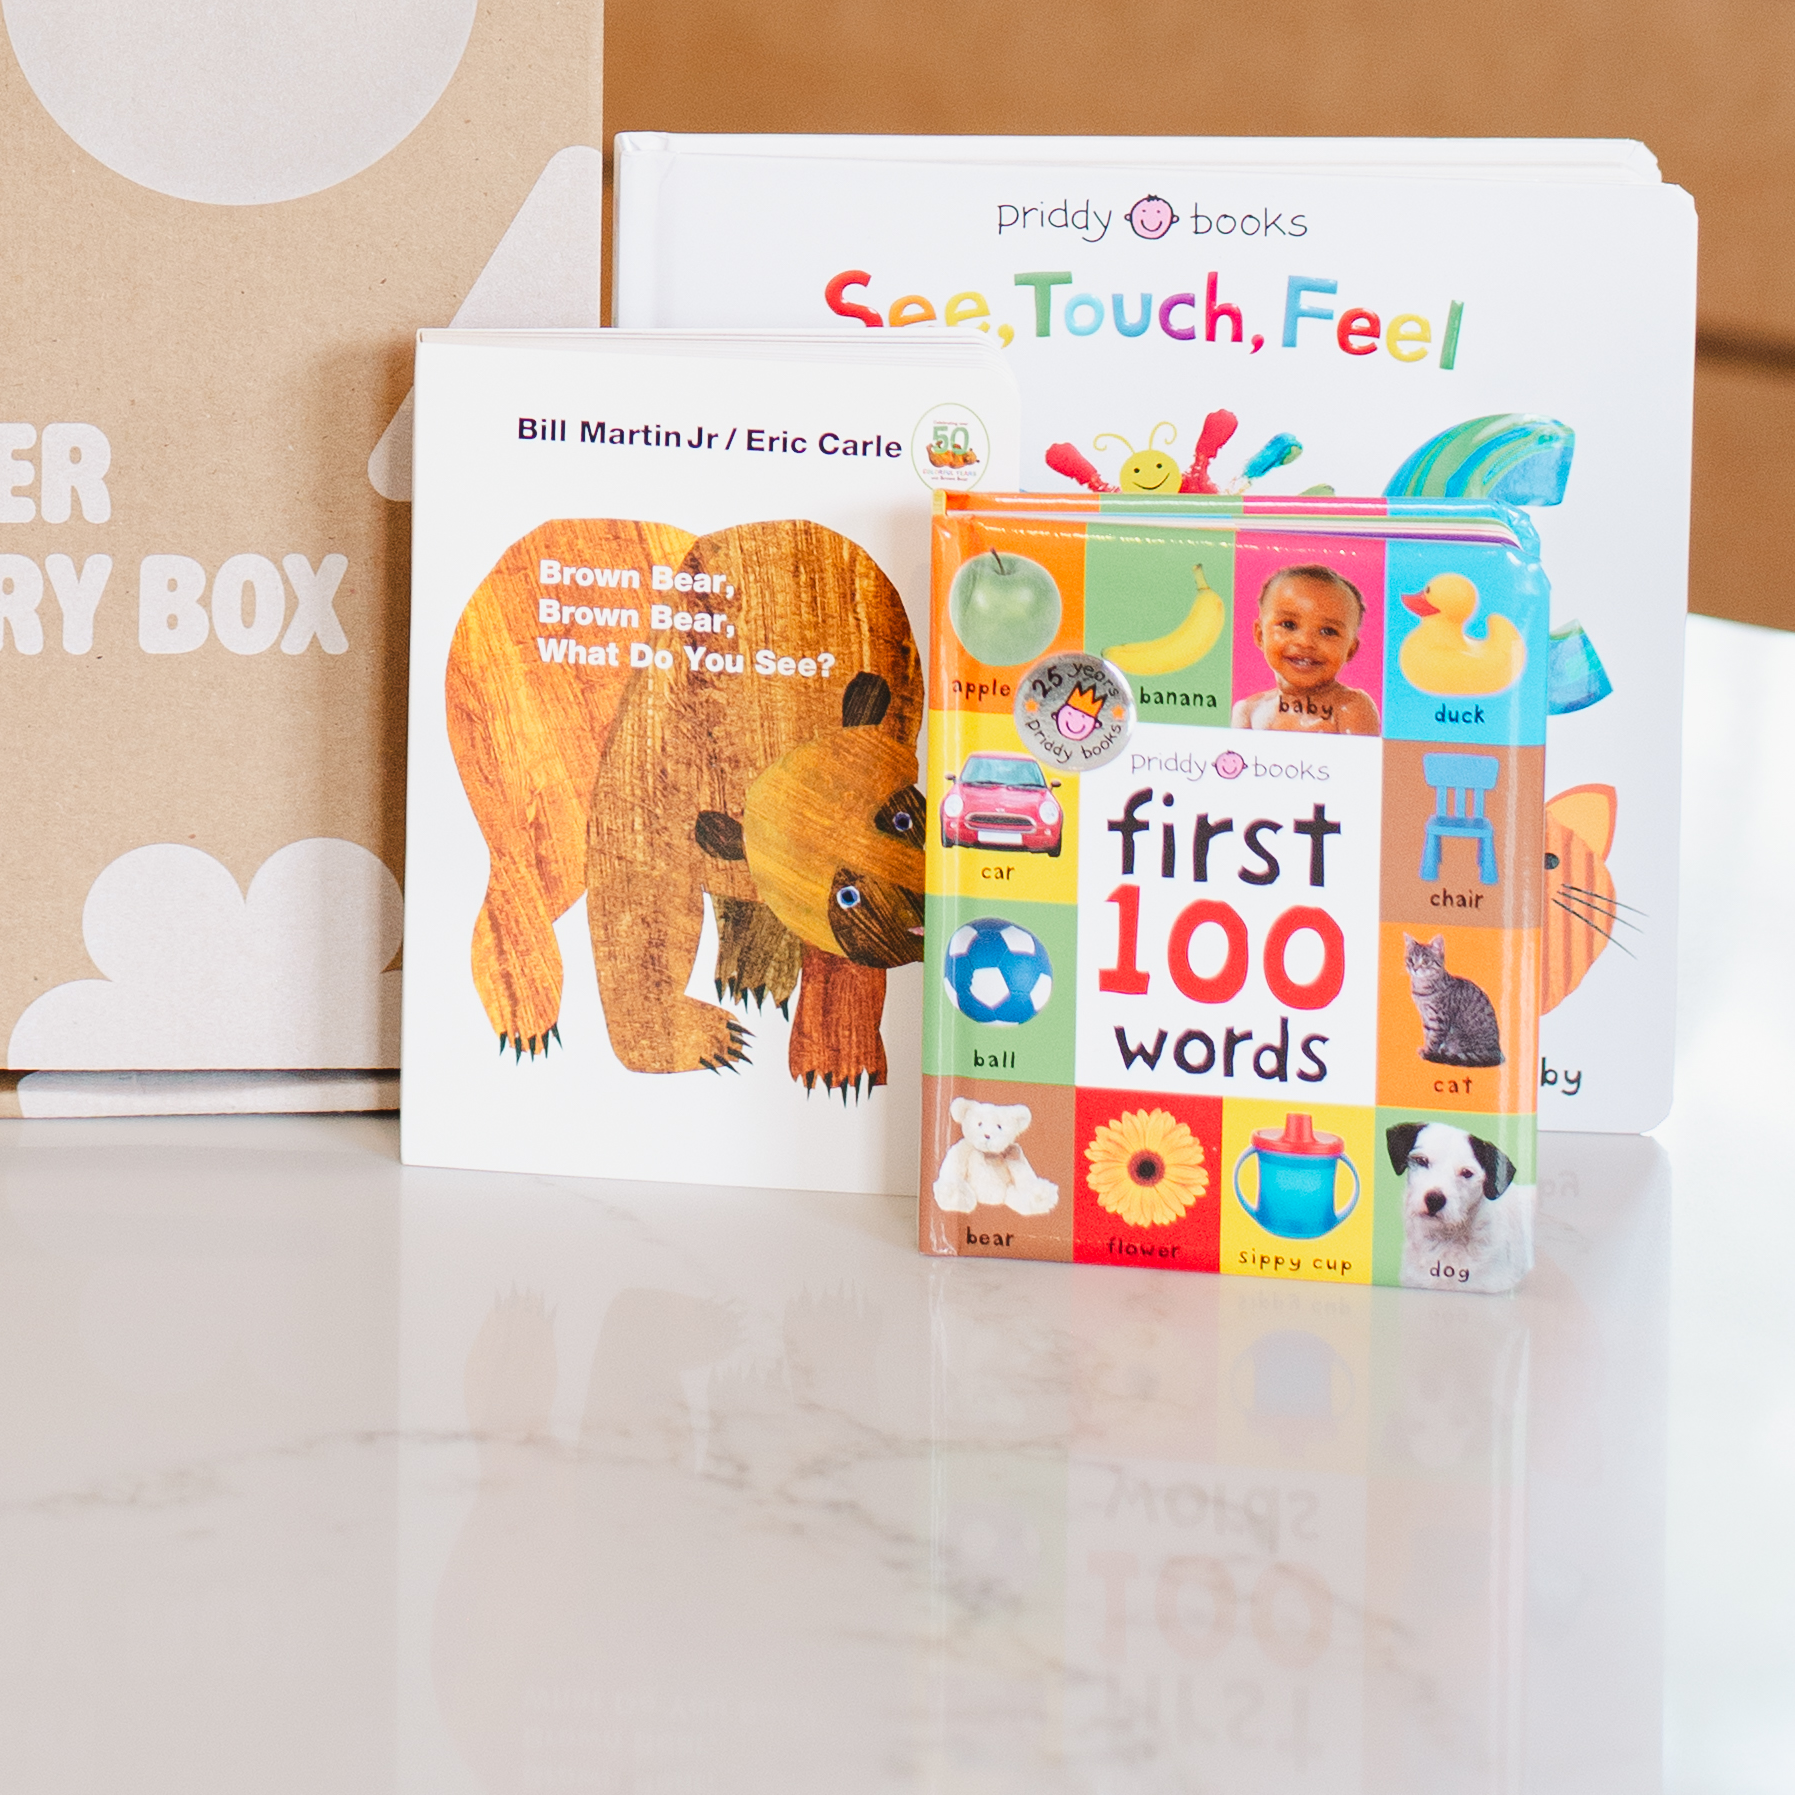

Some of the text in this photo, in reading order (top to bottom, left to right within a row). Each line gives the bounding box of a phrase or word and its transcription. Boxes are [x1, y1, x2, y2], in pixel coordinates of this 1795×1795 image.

[997, 199, 1309, 243] priddy books
[1013, 270, 1265, 355] Touch,
[1281, 273, 1464, 371] Feel
[518, 417, 567, 442] Bill
[580, 420, 681, 449] Martin
[687, 426, 719, 451] Jr
[746, 428, 808, 455] Eric
[817, 432, 903, 459] Carle
[932, 426, 969, 455] 50
[539, 559, 735, 599] Brown Bear,
[138, 552, 350, 656] BOX
[538, 598, 735, 638] Brown Bear,
[537, 637, 836, 678] What Do You See?
[952, 678, 1011, 701] apple
[1032, 663, 1120, 698] 25 years
[1139, 687, 1217, 708] banana
[1278, 696, 1334, 721] baby
[1434, 704, 1485, 725] duck
[1025, 719, 1121, 764] priddy books
[1131, 752, 1331, 781] priddy books
[1107, 787, 1342, 887] first
[981, 864, 1016, 881] car
[1429, 889, 1484, 909] chair
[1098, 883, 1345, 1011] 100
[973, 1049, 1016, 1069] ball
[1113, 1016, 1330, 1083] words
[1433, 1076, 1473, 1095] cat
[1540, 1056, 1581, 1096] by
[966, 1226, 1015, 1247] bear
[1105, 1237, 1180, 1259] flower
[1239, 1249, 1352, 1275] sippy cup
[1429, 1260, 1470, 1283] dog
